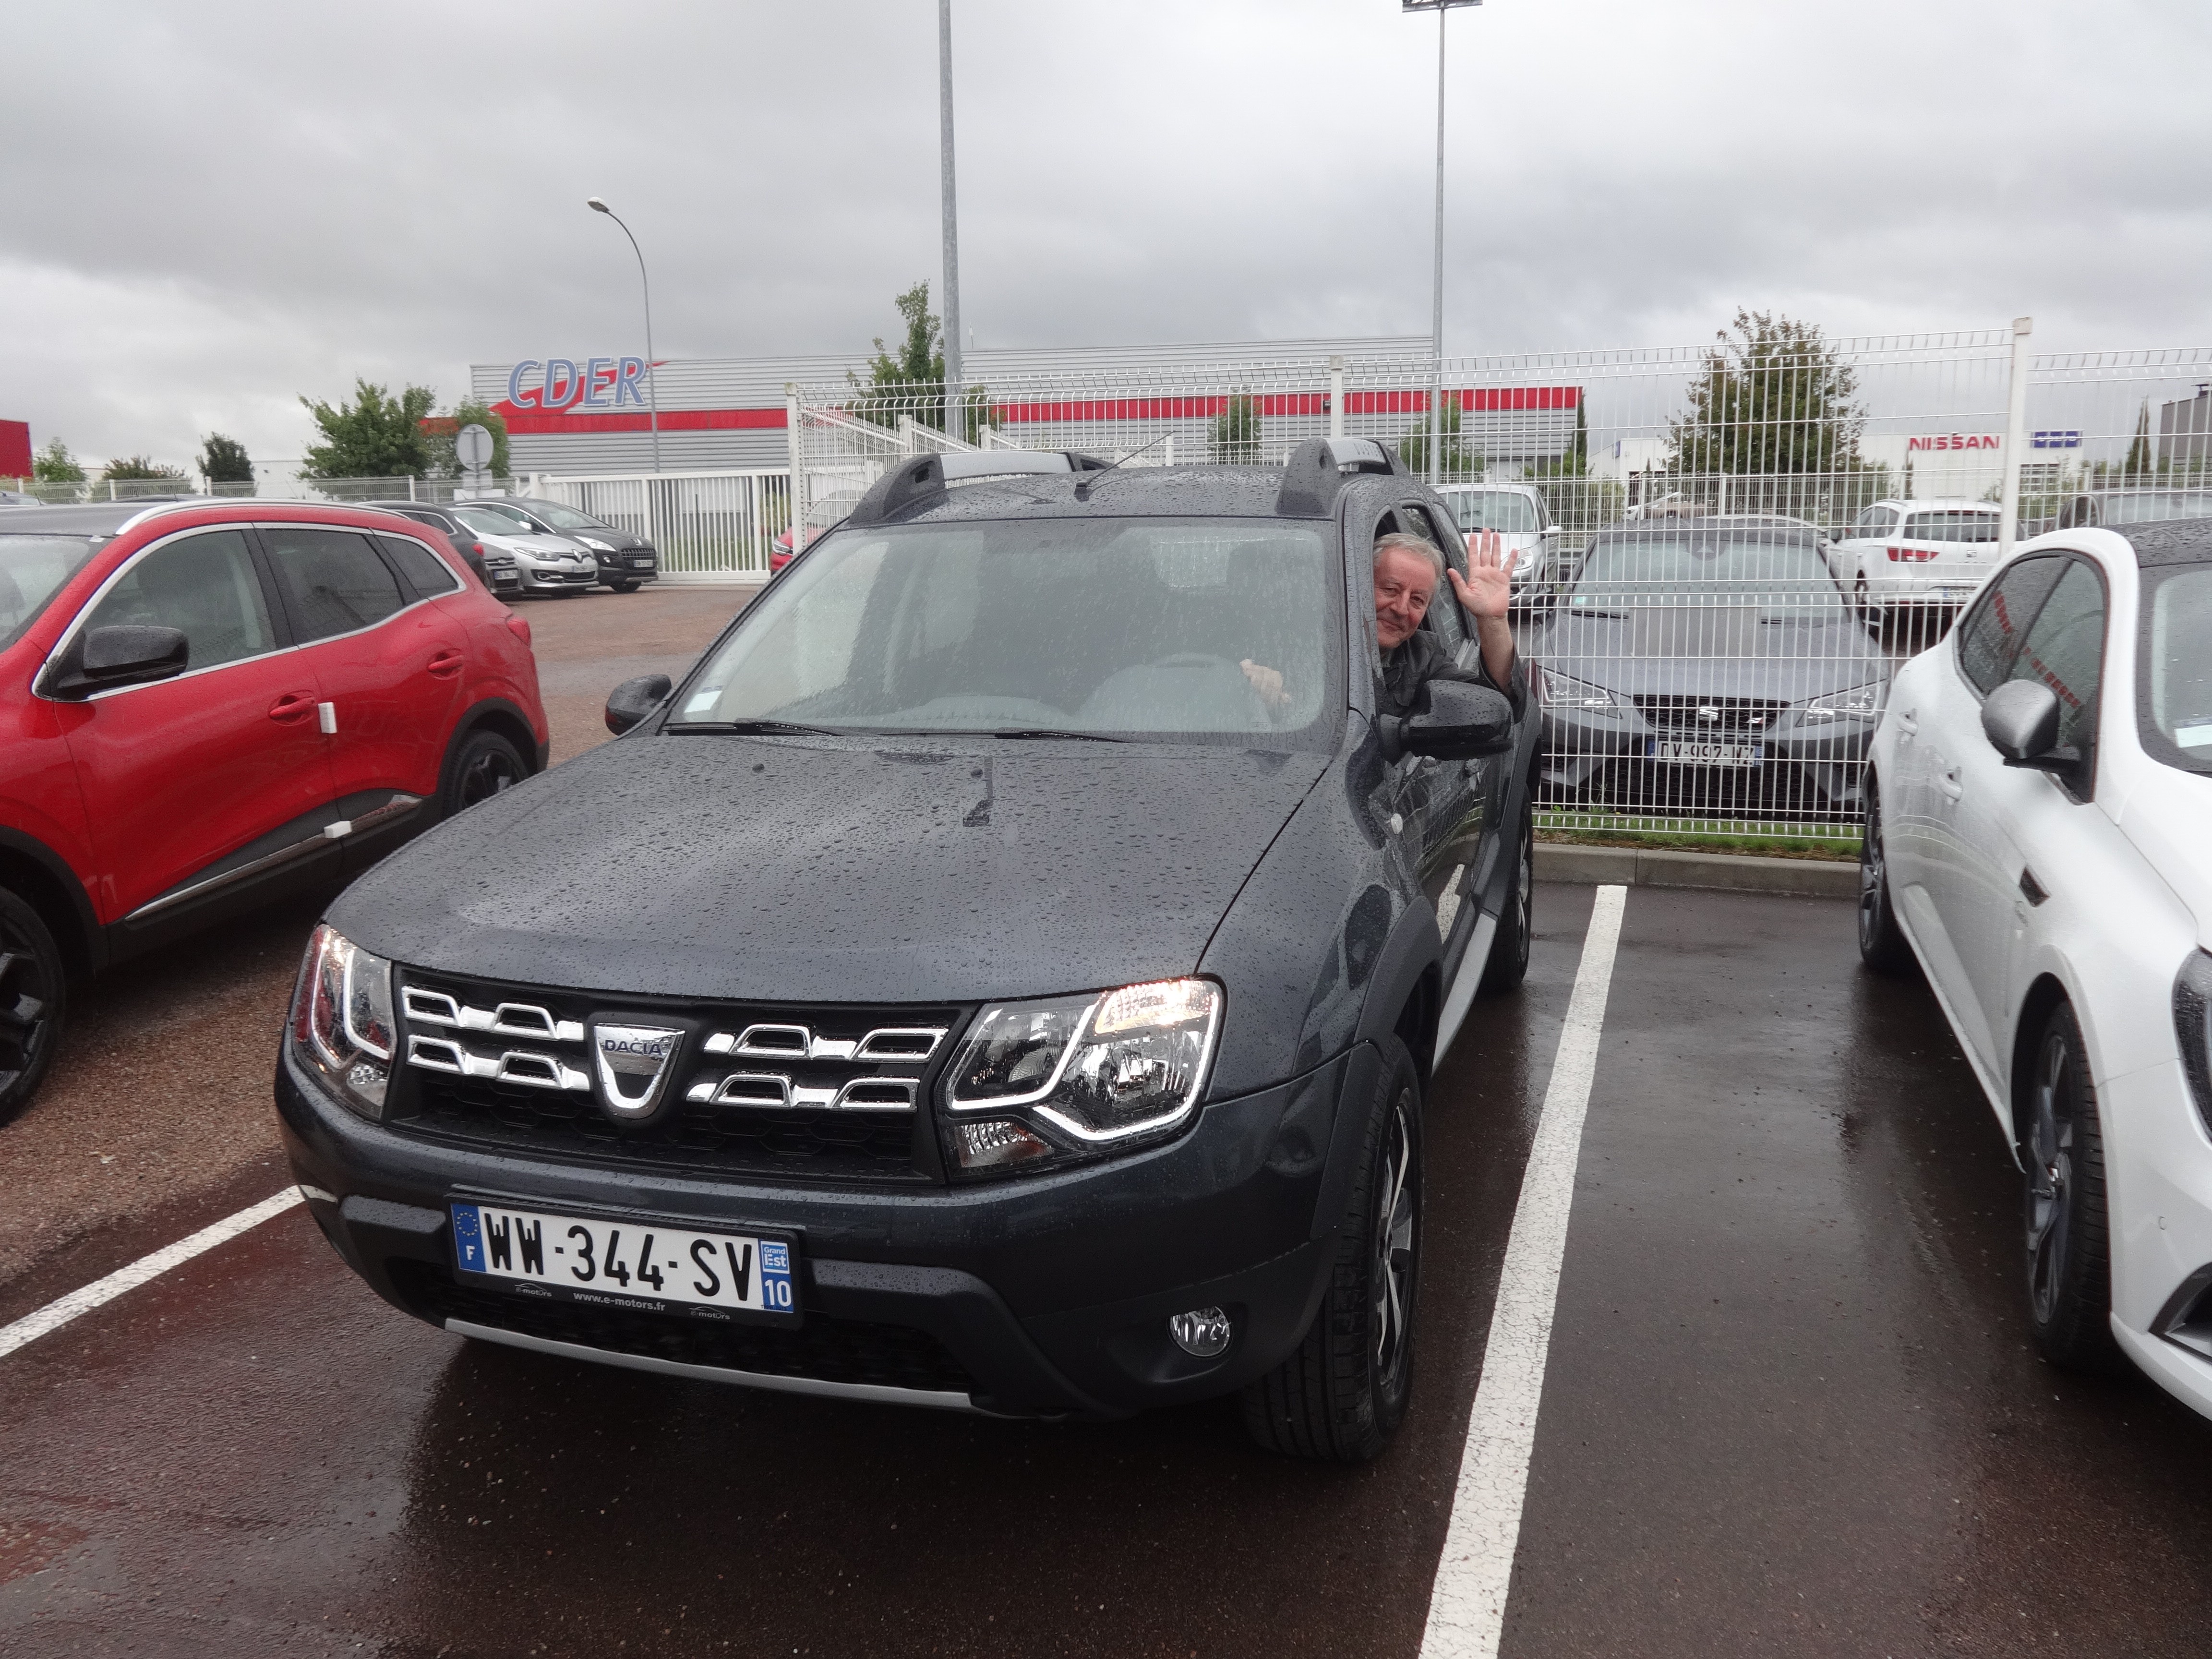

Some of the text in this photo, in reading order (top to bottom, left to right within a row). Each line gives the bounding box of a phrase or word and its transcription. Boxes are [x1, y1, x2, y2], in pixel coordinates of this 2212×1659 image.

[507, 356, 647, 409] CDER
[1909, 435, 2000, 451] NISSAN
[604, 1039, 663, 1056] DACIA
[466, 1245, 475, 1260] F
[484, 1213, 752, 1301] WW-344-SV
[764, 1247, 785, 1255] Grand
[764, 1253, 786, 1267] Est
[765, 1279, 792, 1307] 10
[573, 1293, 666, 1311] www.e-motors.fr
